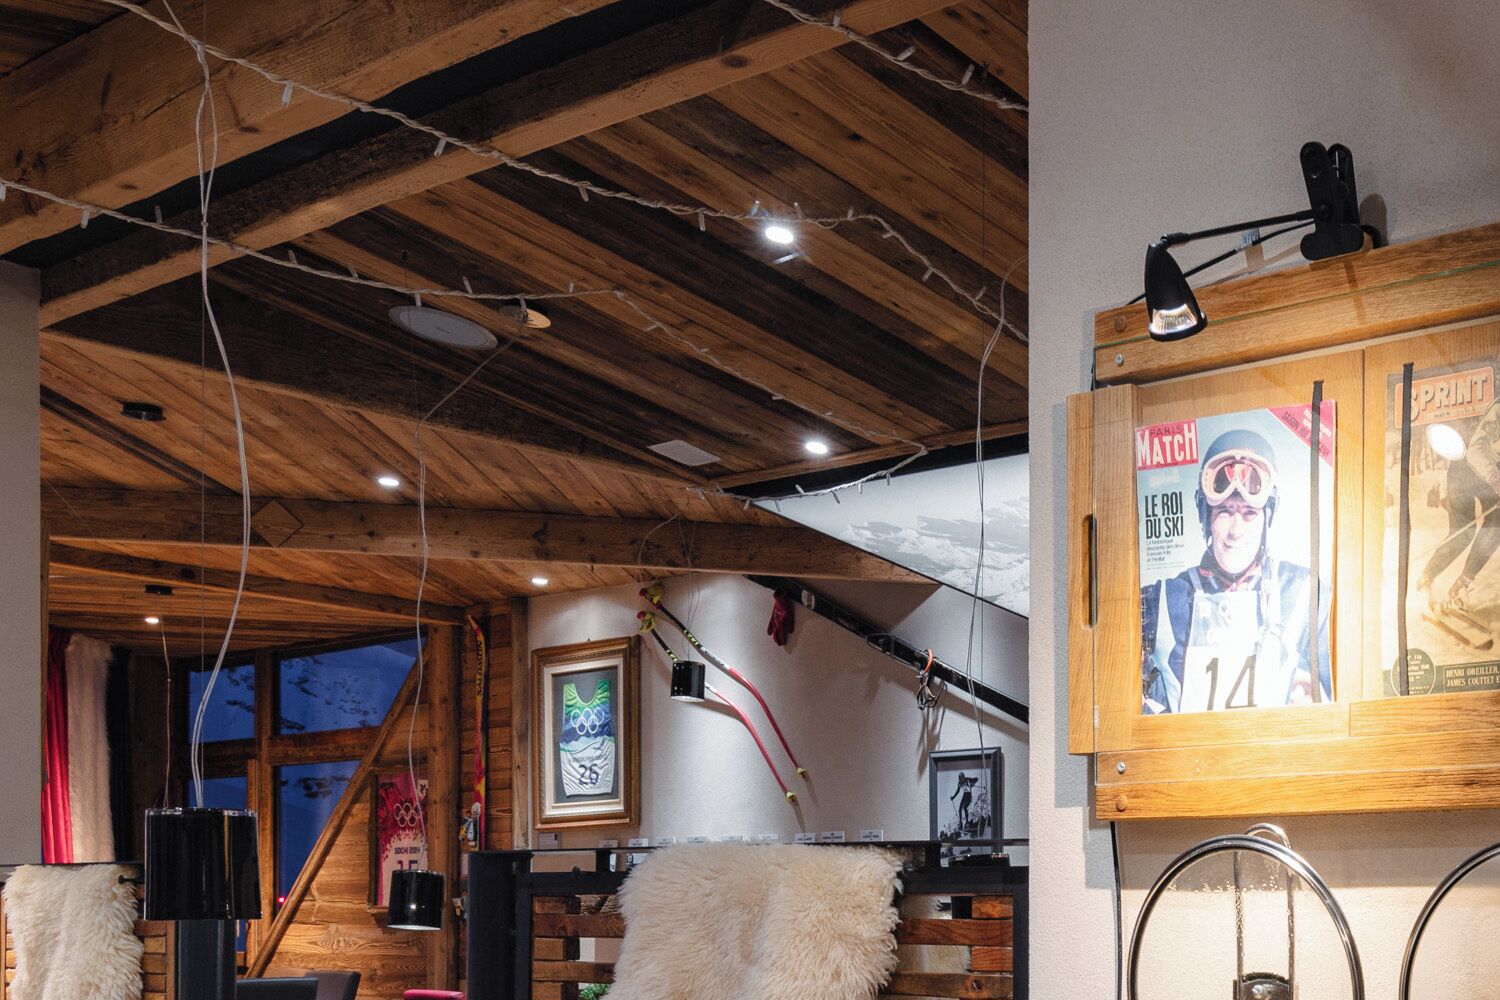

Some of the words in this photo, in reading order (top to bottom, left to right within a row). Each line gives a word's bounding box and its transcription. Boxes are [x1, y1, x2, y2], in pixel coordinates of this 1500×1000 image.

[1150, 424, 1183, 436] PARIS
[1137, 422, 1198, 467] MATCH
[1145, 494, 1158, 518] LE
[1161, 491, 1184, 517] ROI
[1145, 517, 1162, 539] DU
[1164, 515, 1184, 538] SKI
[1206, 654, 1257, 711] 14
[1446, 668, 1465, 678] HENRI
[1446, 678, 1466, 687] JAMES
[578, 763, 599, 785] 26
[394, 846, 409, 855] SOCHI
